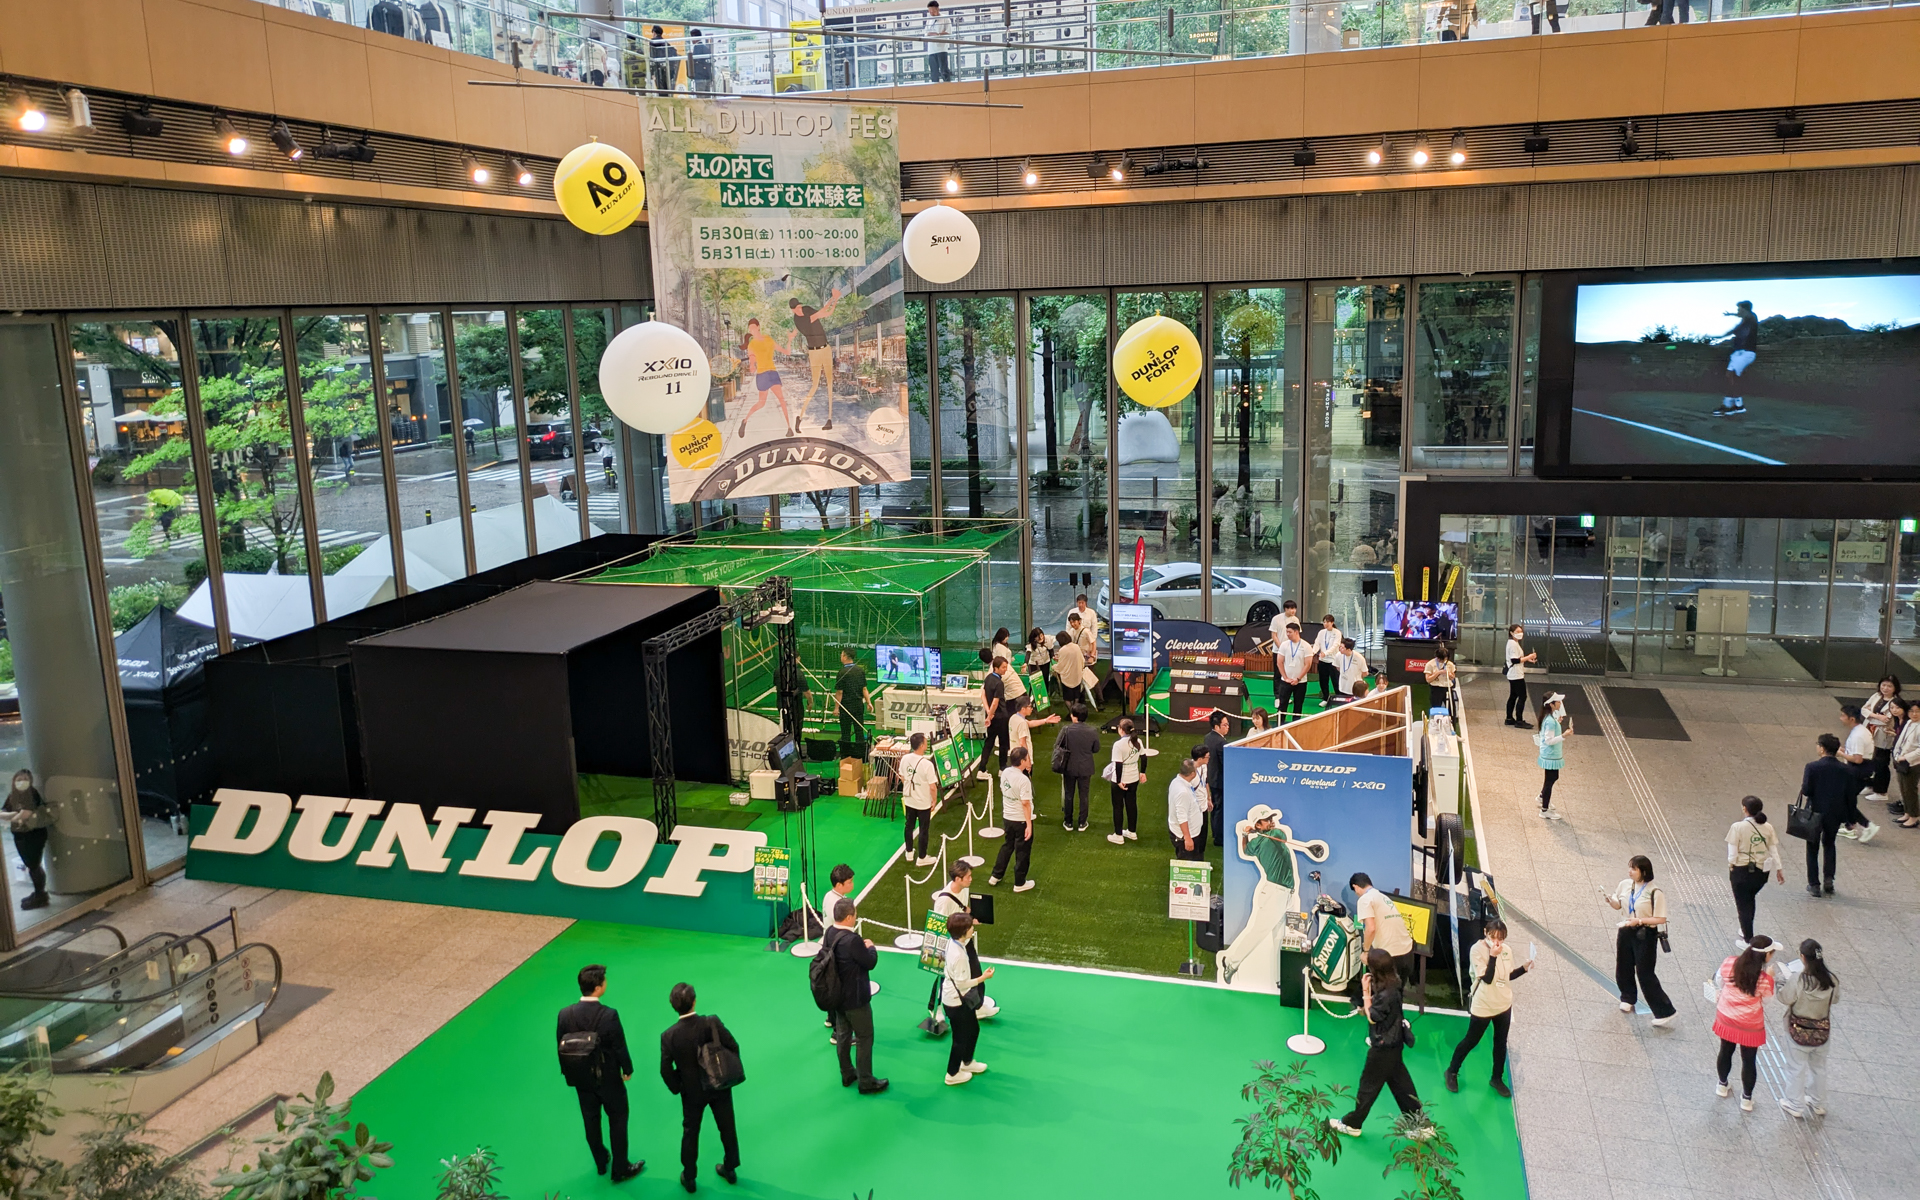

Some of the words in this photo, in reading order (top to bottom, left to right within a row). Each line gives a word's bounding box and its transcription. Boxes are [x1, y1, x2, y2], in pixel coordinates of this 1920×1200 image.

[854, 6, 876, 14] history
[648, 105, 701, 133] ALL
[718, 109, 833, 137] DUNLOP
[848, 114, 893, 139] FES
[687, 154, 773, 178] 丸の内で
[600, 182, 635, 215] DUNLOP
[722, 184, 863, 207] 心はずむ体験を
[700, 226, 774, 240] 5月30日(金)
[930, 235, 962, 247] SRIXON
[701, 246, 775, 260] 5月31日(土)
[945, 246, 950, 255] 1
[1131, 345, 1180, 381] DUNLOP
[1147, 350, 1155, 359] 3
[643, 357, 692, 374] XXIO
[1146, 359, 1176, 383] FORT
[665, 381, 682, 395] 11
[679, 434, 713, 453] DUNLOP
[688, 443, 709, 455] FORT
[734, 446, 878, 483] DUNLOP
[703, 568, 718, 583] TAKE
[719, 561, 735, 576] YOUR
[1165, 639, 1220, 650] Cleveland
[1289, 763, 1357, 775] DUNLOP
[1250, 773, 1287, 785] SRIXON
[1300, 778, 1337, 788] Cleveland
[1351, 781, 1386, 790] XXIO
[190, 788, 767, 897] DUNLOP
[1314, 929, 1340, 976] SRIXON
